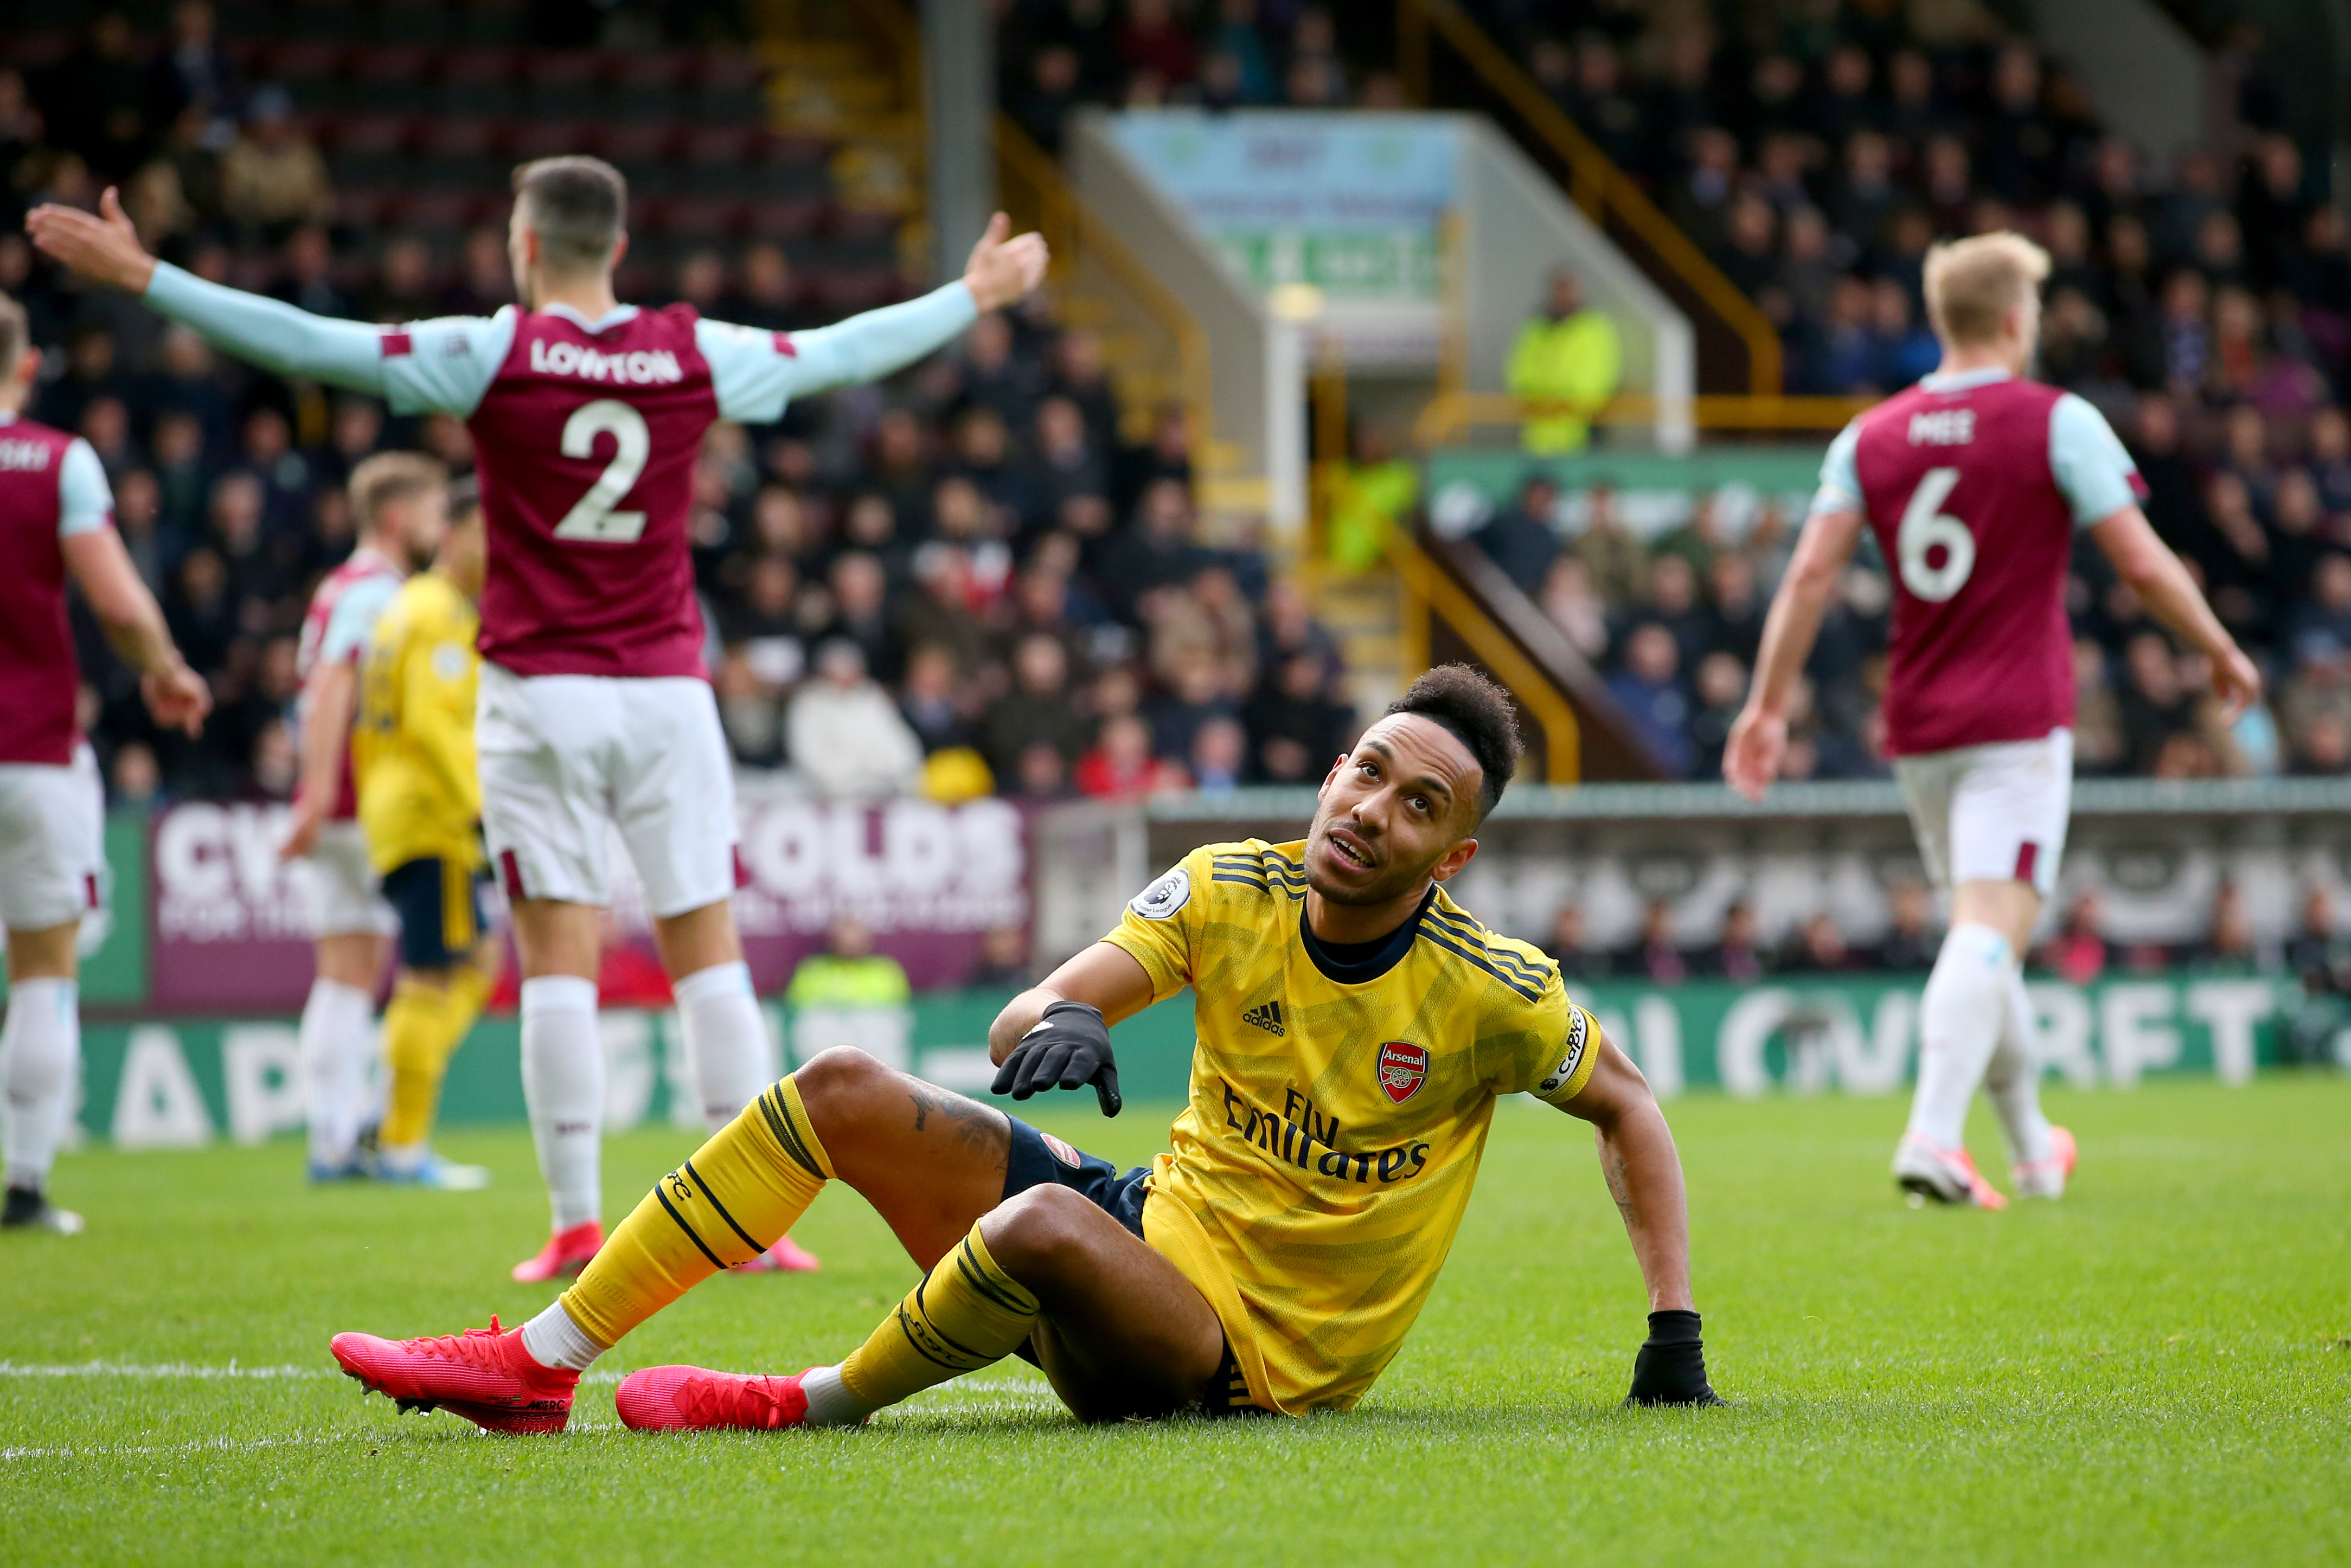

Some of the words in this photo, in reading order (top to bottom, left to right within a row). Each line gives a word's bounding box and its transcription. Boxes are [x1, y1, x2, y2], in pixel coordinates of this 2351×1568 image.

[530, 338, 683, 384] LOWTON
[1907, 408, 1977, 447] MEE
[552, 399, 650, 543] 2
[1898, 466, 1976, 603] 6
[1138, 903, 1152, 912] Premier
[1153, 903, 1172, 913] League
[1243, 1013, 1285, 1037] adidas
[1384, 1050, 1423, 1065] Arsenal
[1218, 1076, 1430, 1184] Emirates
[1284, 1088, 1339, 1149] Fly
